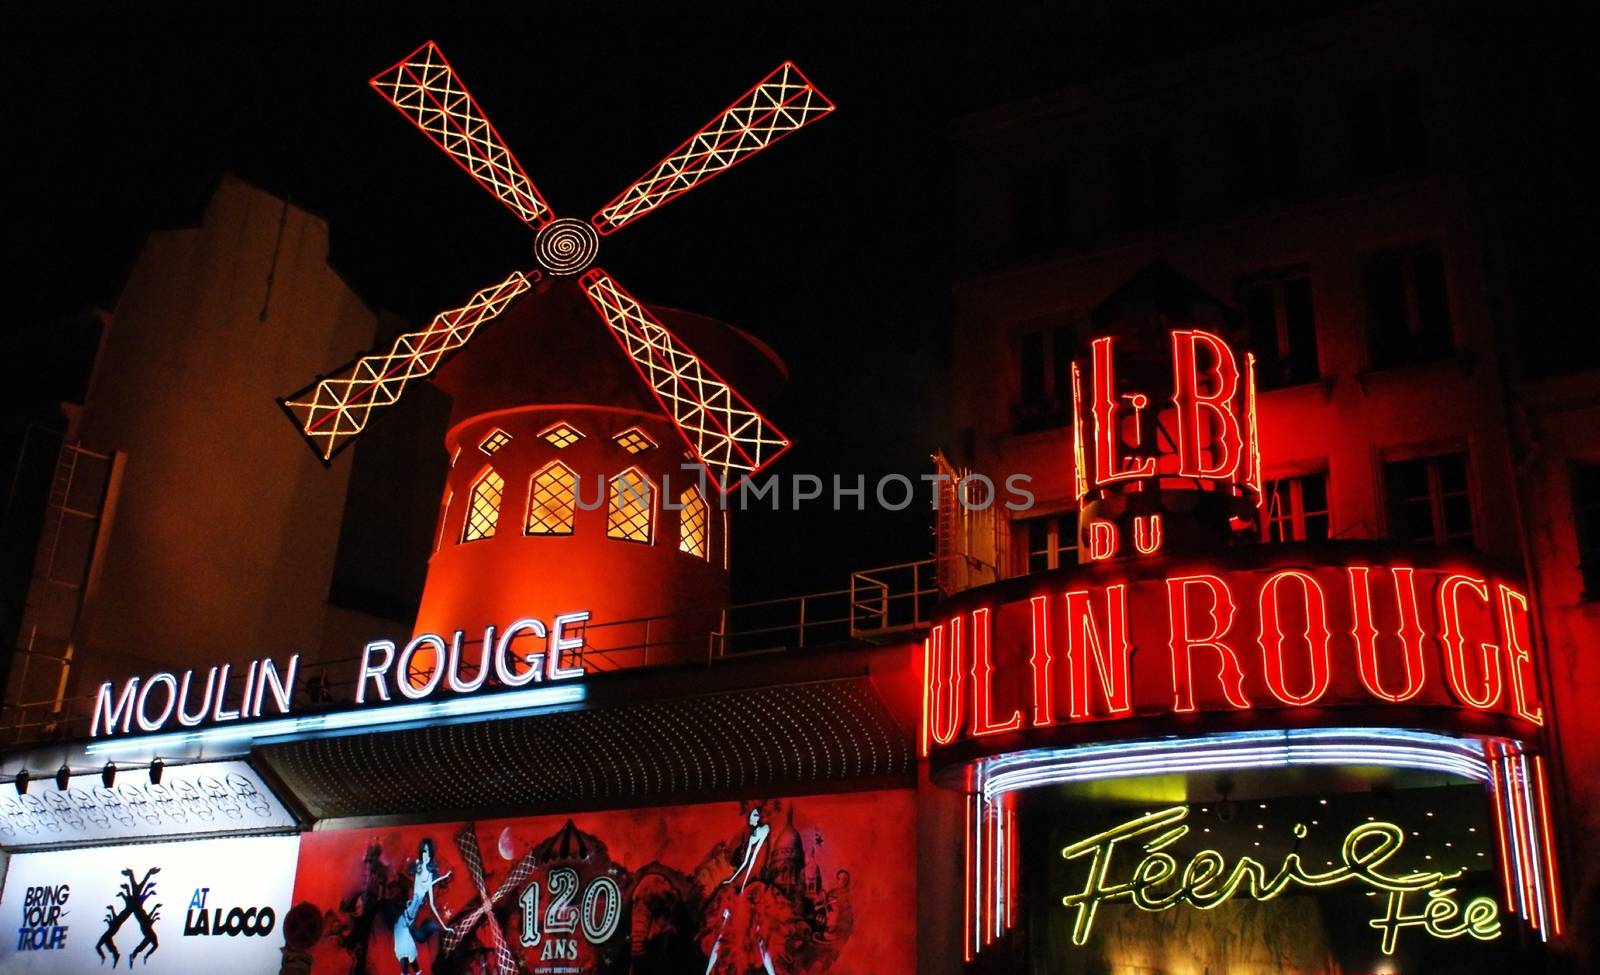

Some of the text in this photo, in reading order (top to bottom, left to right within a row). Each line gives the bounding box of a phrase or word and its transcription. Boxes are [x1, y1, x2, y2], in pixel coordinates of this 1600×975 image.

[1090, 514, 1161, 560] DU
[1166, 566, 1544, 726] ROUGE
[90, 611, 591, 738] MOULIN ROUGE
[24, 884, 71, 907] BRING
[189, 887, 210, 909] AT
[518, 867, 622, 947] 120
[23, 906, 61, 928] YOUR
[183, 906, 276, 937] LA LOCO
[17, 926, 69, 951] TROUPE
[540, 939, 578, 961] ANS
